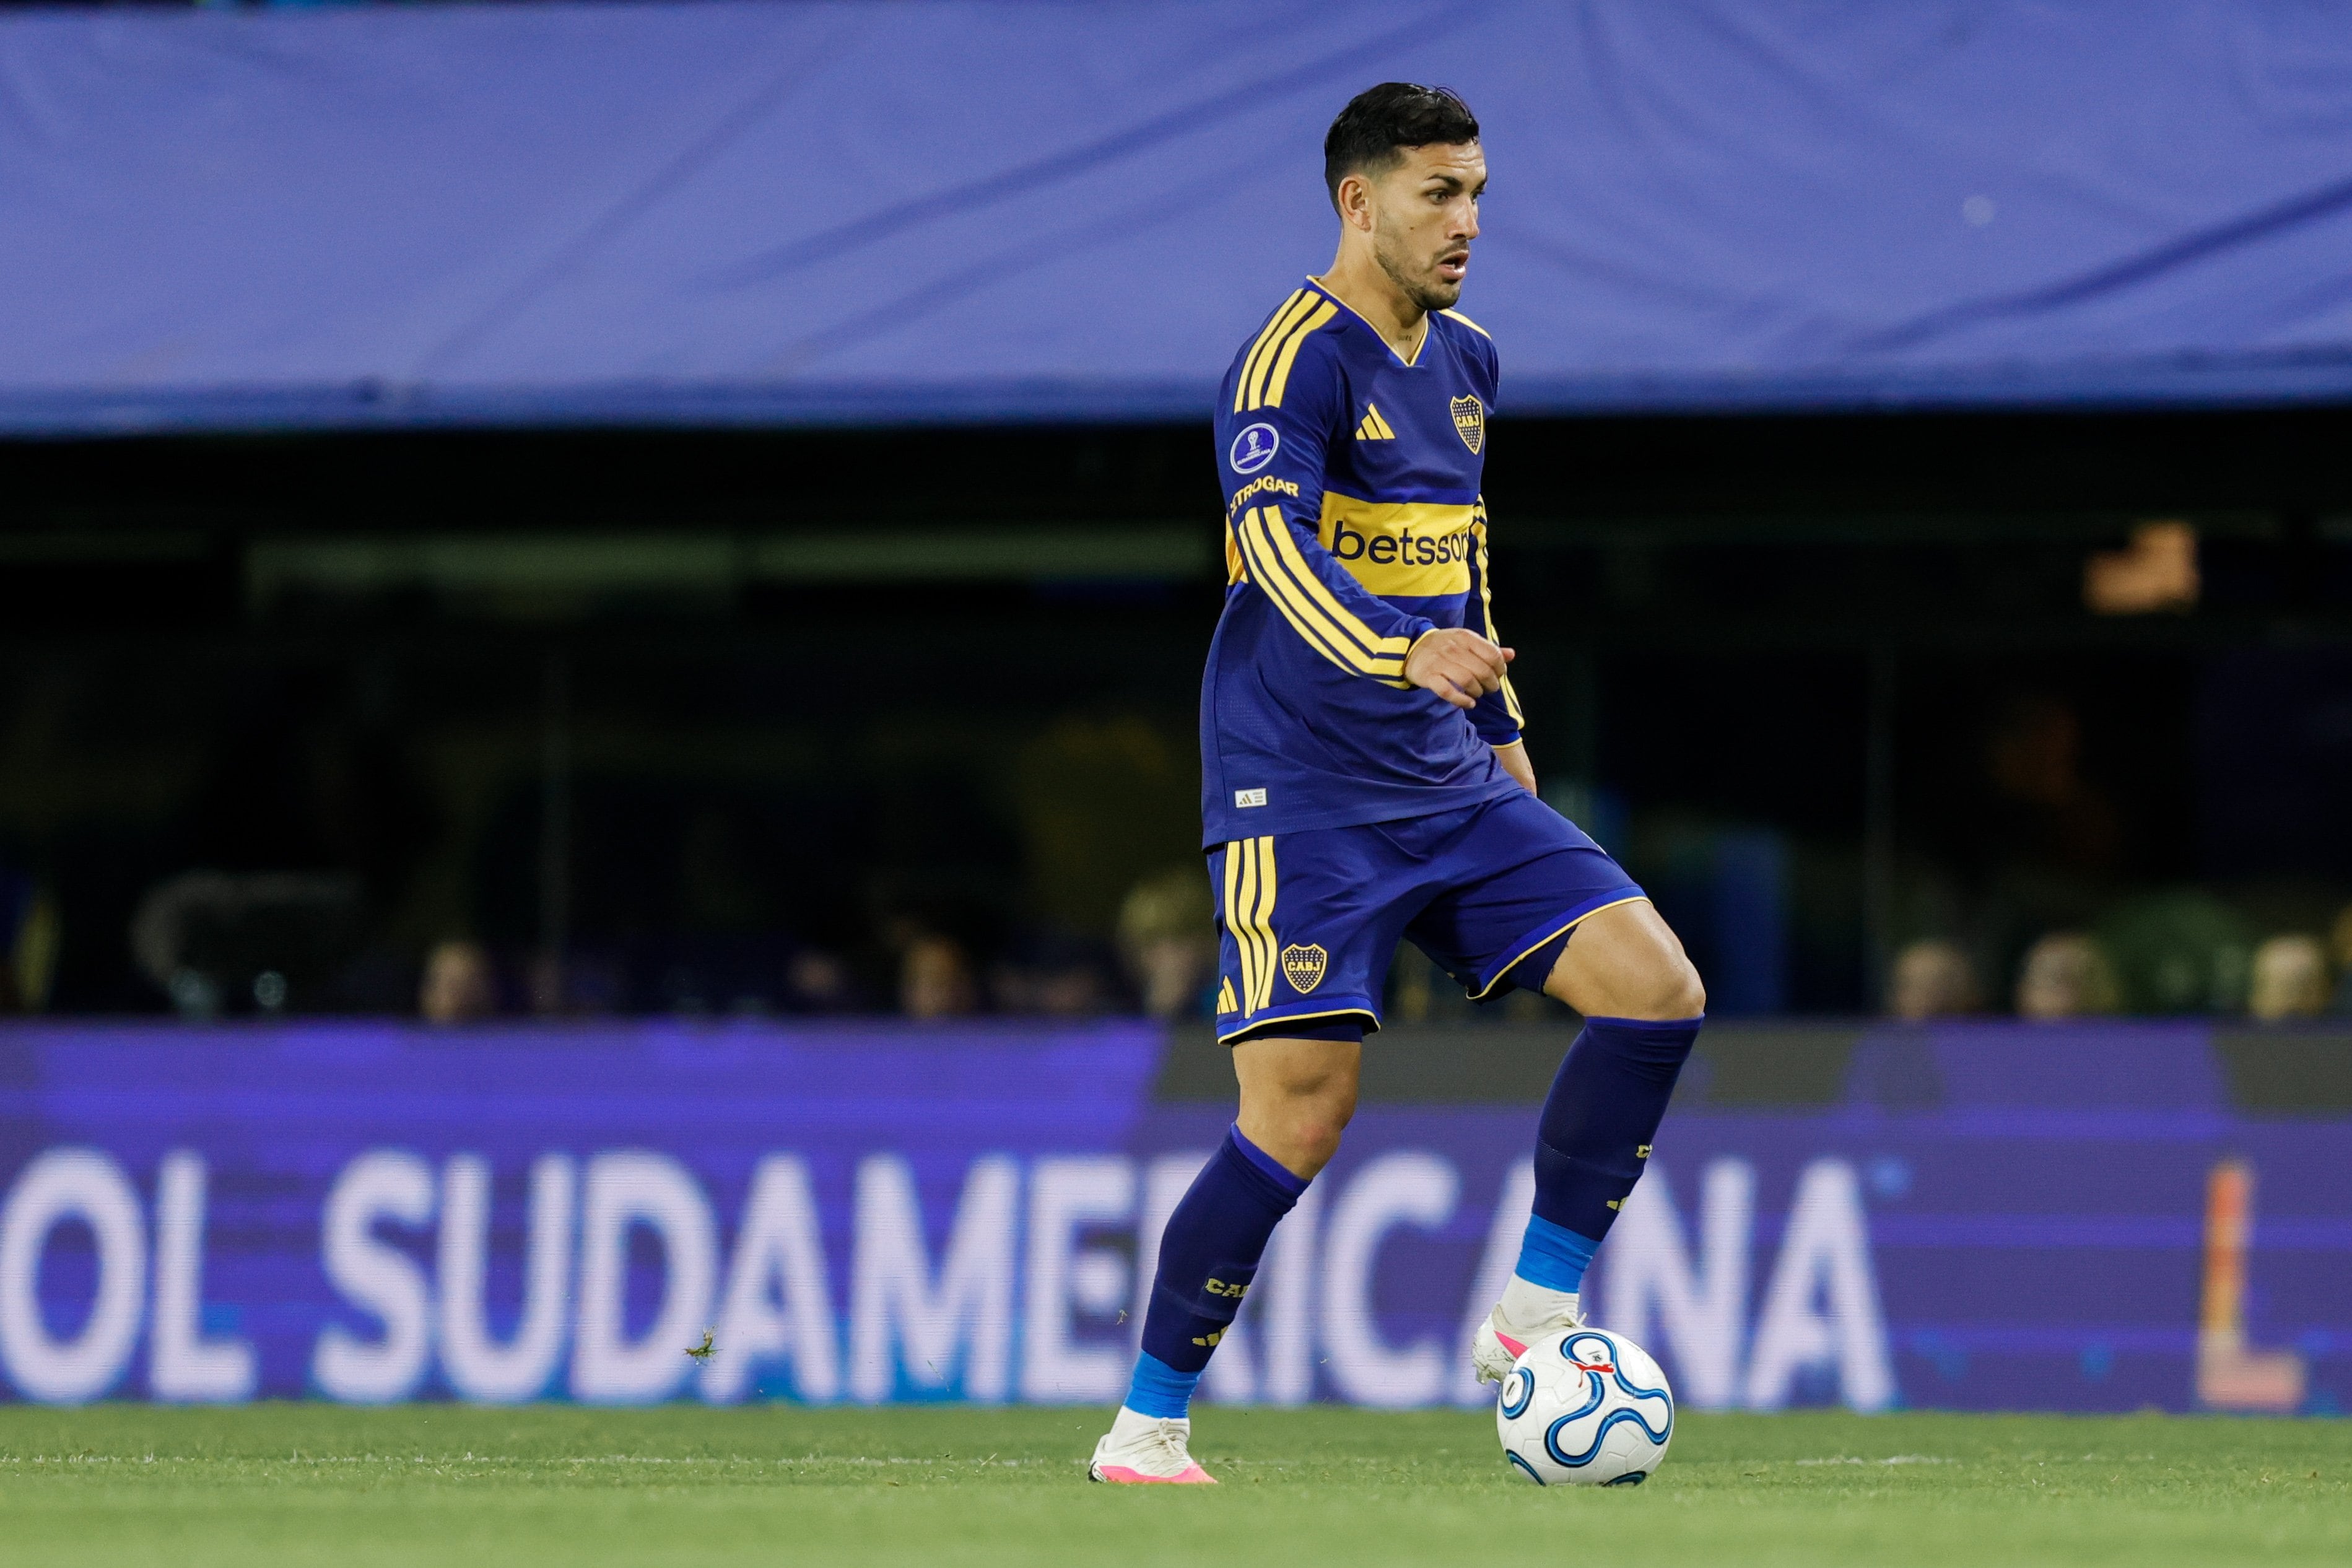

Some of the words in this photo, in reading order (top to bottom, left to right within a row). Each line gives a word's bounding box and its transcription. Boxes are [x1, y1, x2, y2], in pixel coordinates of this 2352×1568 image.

[1456, 414, 1479, 427] CABJ
[1288, 961, 1320, 972] CABJ
[313, 1149, 1896, 1407] SUDAMEICNA
